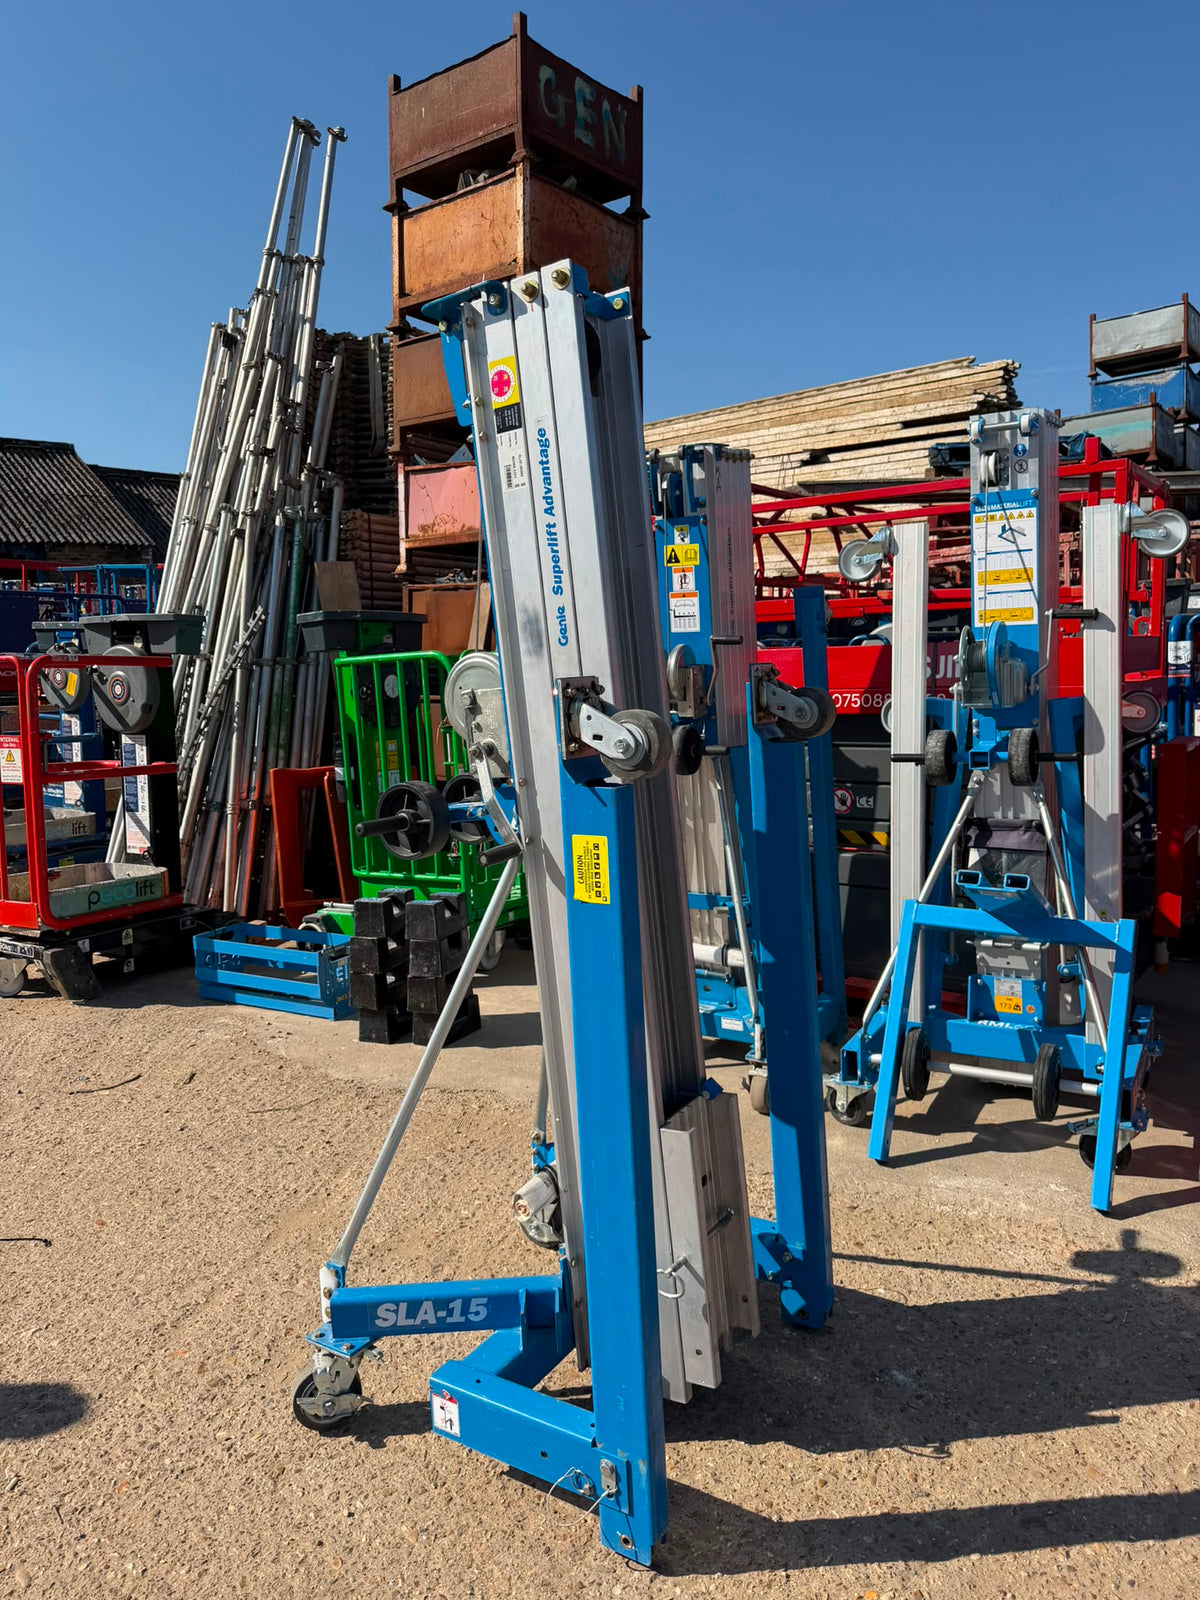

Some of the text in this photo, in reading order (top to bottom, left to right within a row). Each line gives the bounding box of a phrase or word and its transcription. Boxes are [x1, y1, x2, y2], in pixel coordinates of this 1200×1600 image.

[538, 64, 627, 164] GEN
[537, 427, 569, 648] Genie Superlift Advantage
[576, 854, 585, 885] CAUTION
[87, 880, 156, 911] pecolift
[374, 1297, 489, 1328] SLA-15
